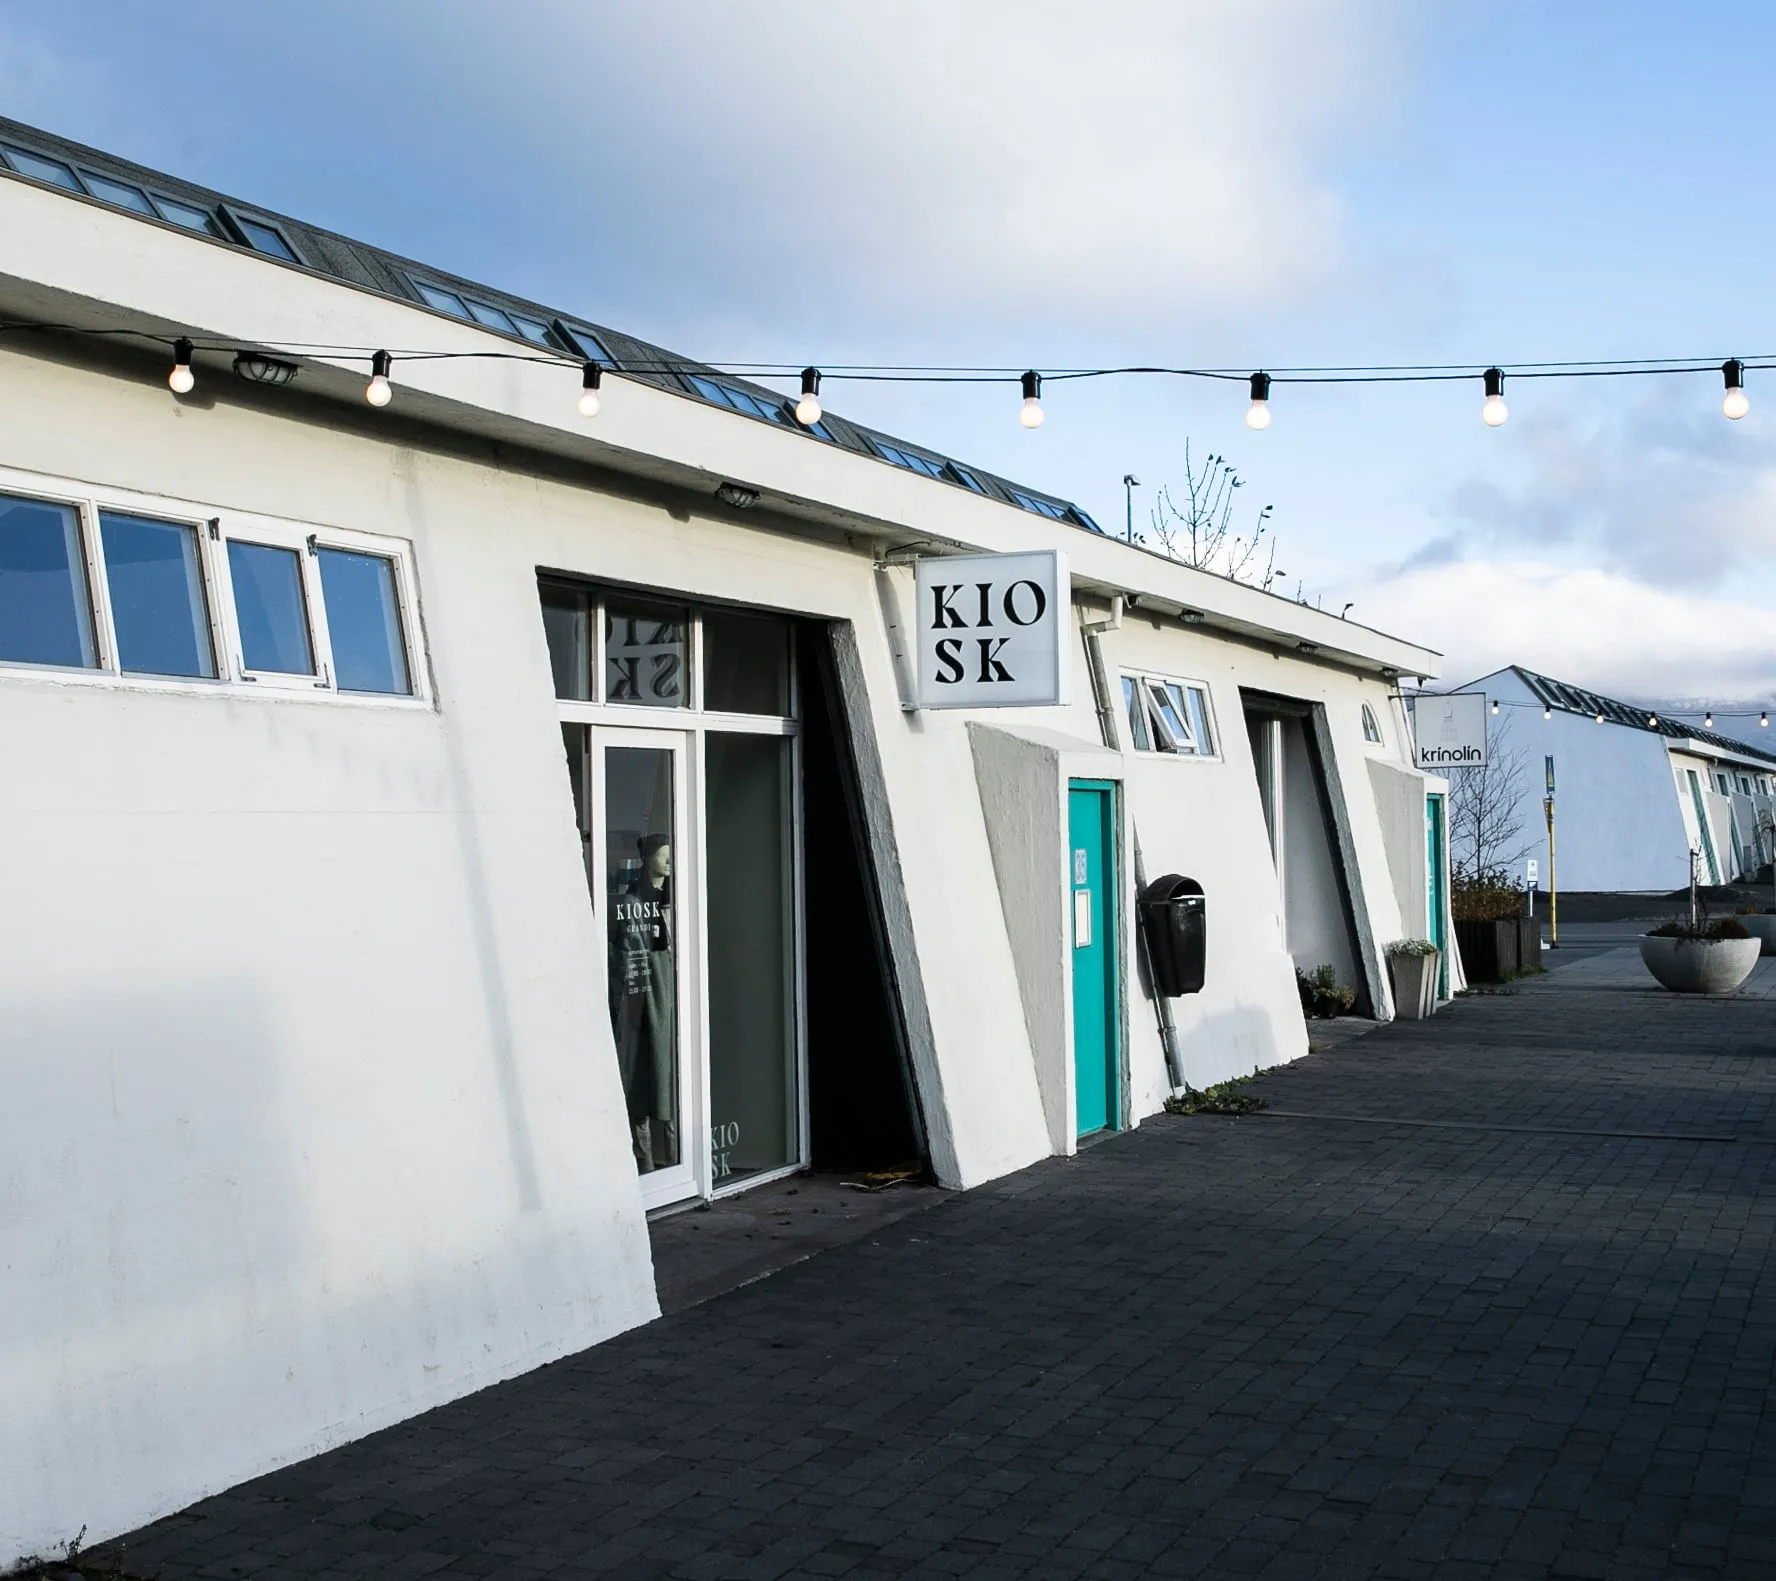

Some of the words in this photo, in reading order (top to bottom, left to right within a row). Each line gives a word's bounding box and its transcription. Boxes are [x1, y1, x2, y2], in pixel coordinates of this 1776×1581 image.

[930, 580, 1046, 630] KIO
[935, 637, 1016, 684] SK
[616, 901, 660, 920] KIOSK
